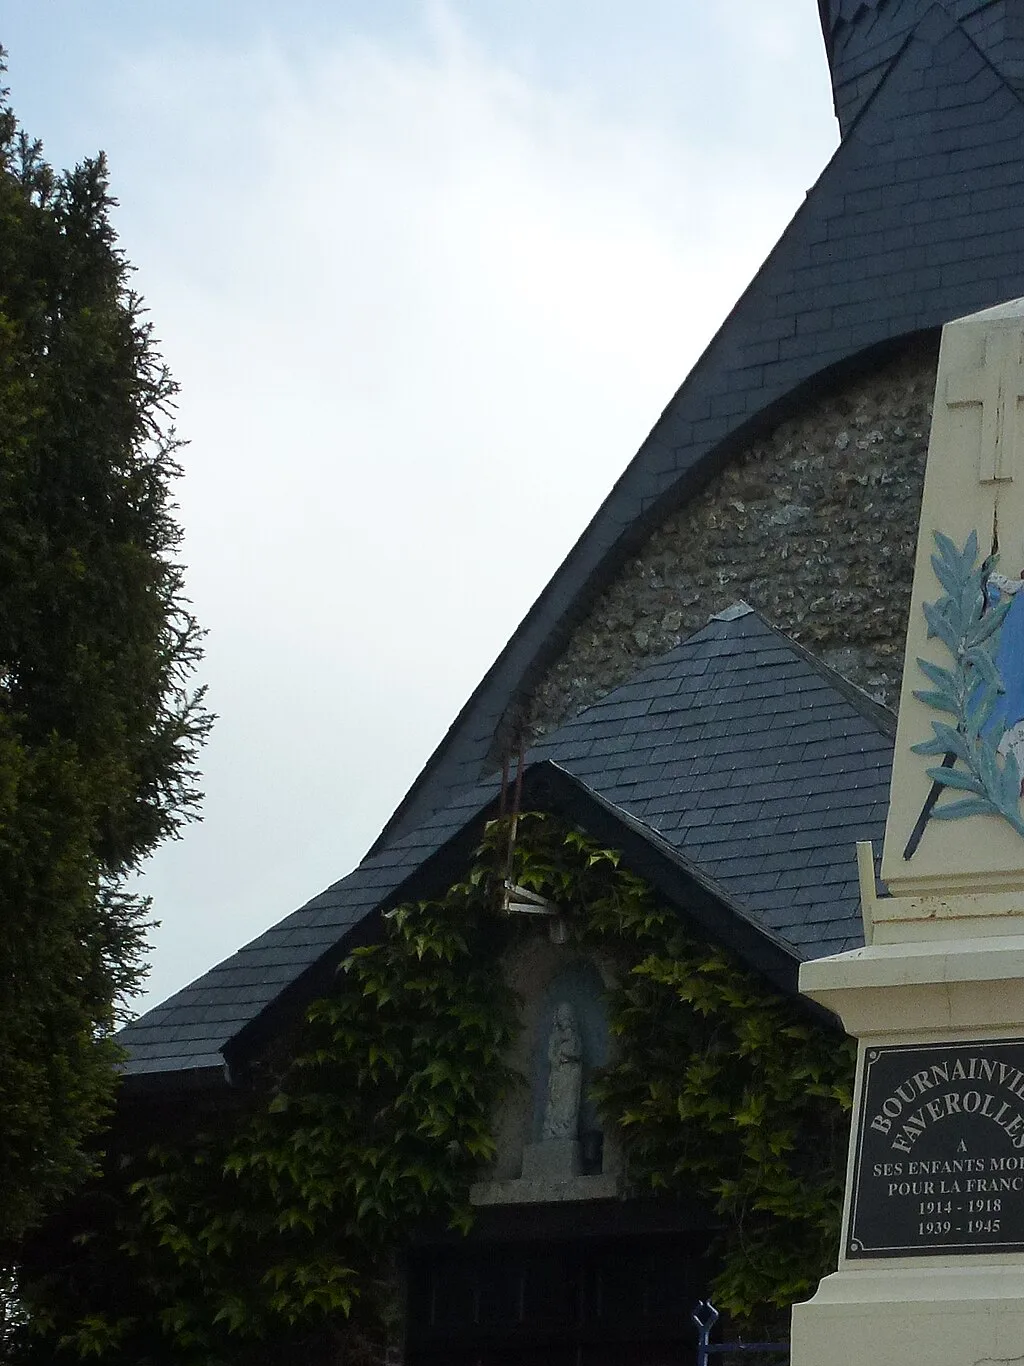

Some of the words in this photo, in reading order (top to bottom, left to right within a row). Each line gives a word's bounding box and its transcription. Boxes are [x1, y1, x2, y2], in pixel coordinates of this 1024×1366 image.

[957, 1139, 967, 1152] A
[873, 1162, 903, 1177] SES
[908, 1159, 984, 1175] ENFANTS
[888, 1182, 934, 1196] POUR
[940, 1180, 961, 1193] LA
[919, 1201, 952, 1214] 1914
[969, 1199, 1001, 1212] 1918
[919, 1222, 950, 1235] 1939
[968, 1220, 1000, 1233] 1945
